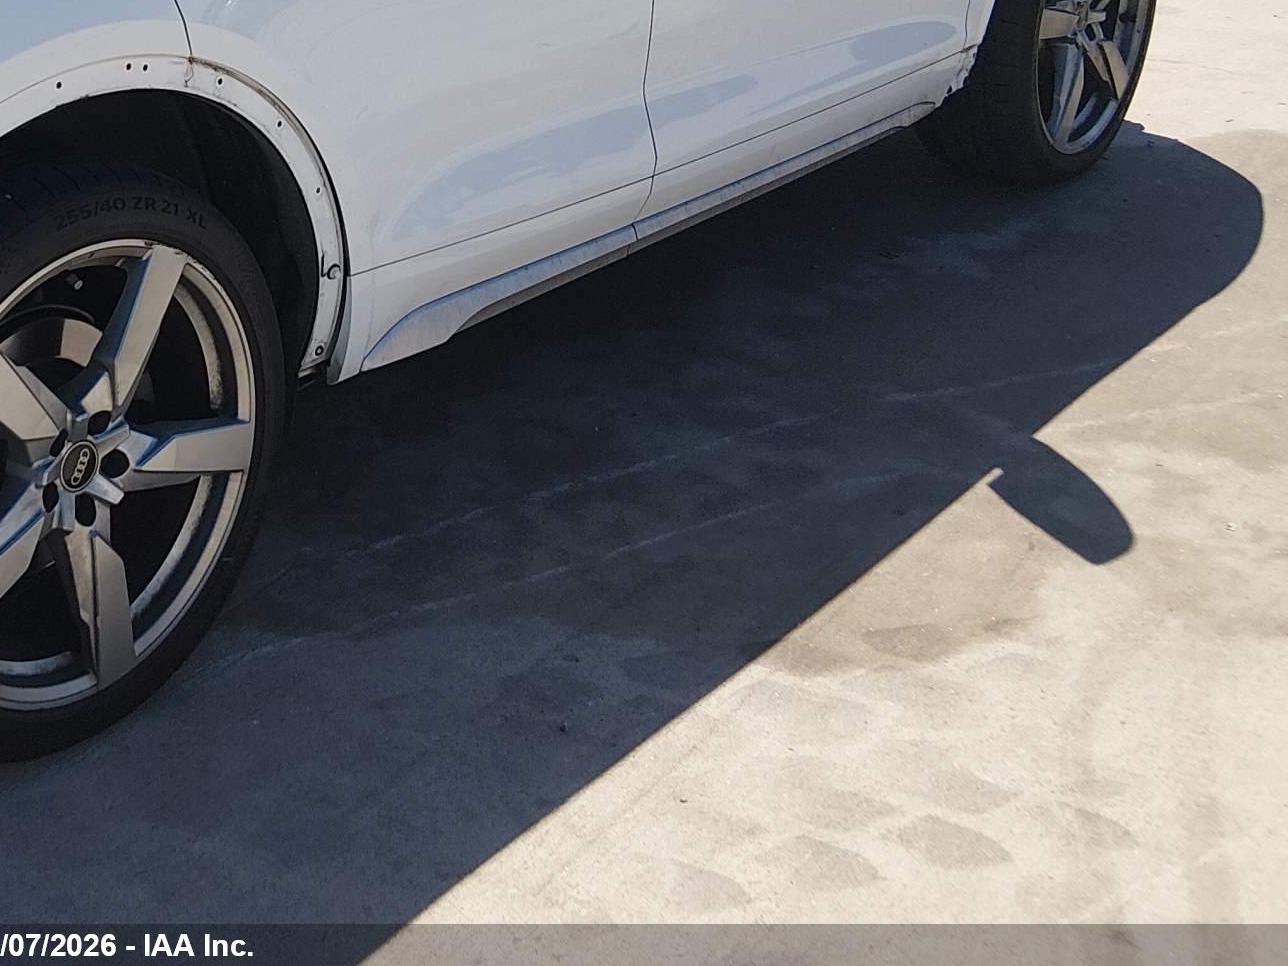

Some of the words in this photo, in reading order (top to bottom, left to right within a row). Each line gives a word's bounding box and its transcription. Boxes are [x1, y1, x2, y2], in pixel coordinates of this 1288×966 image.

[54, 197, 126, 231] 255/40
[132, 196, 157, 211] ZR
[161, 199, 180, 217] 21
[186, 208, 207, 229] XL
